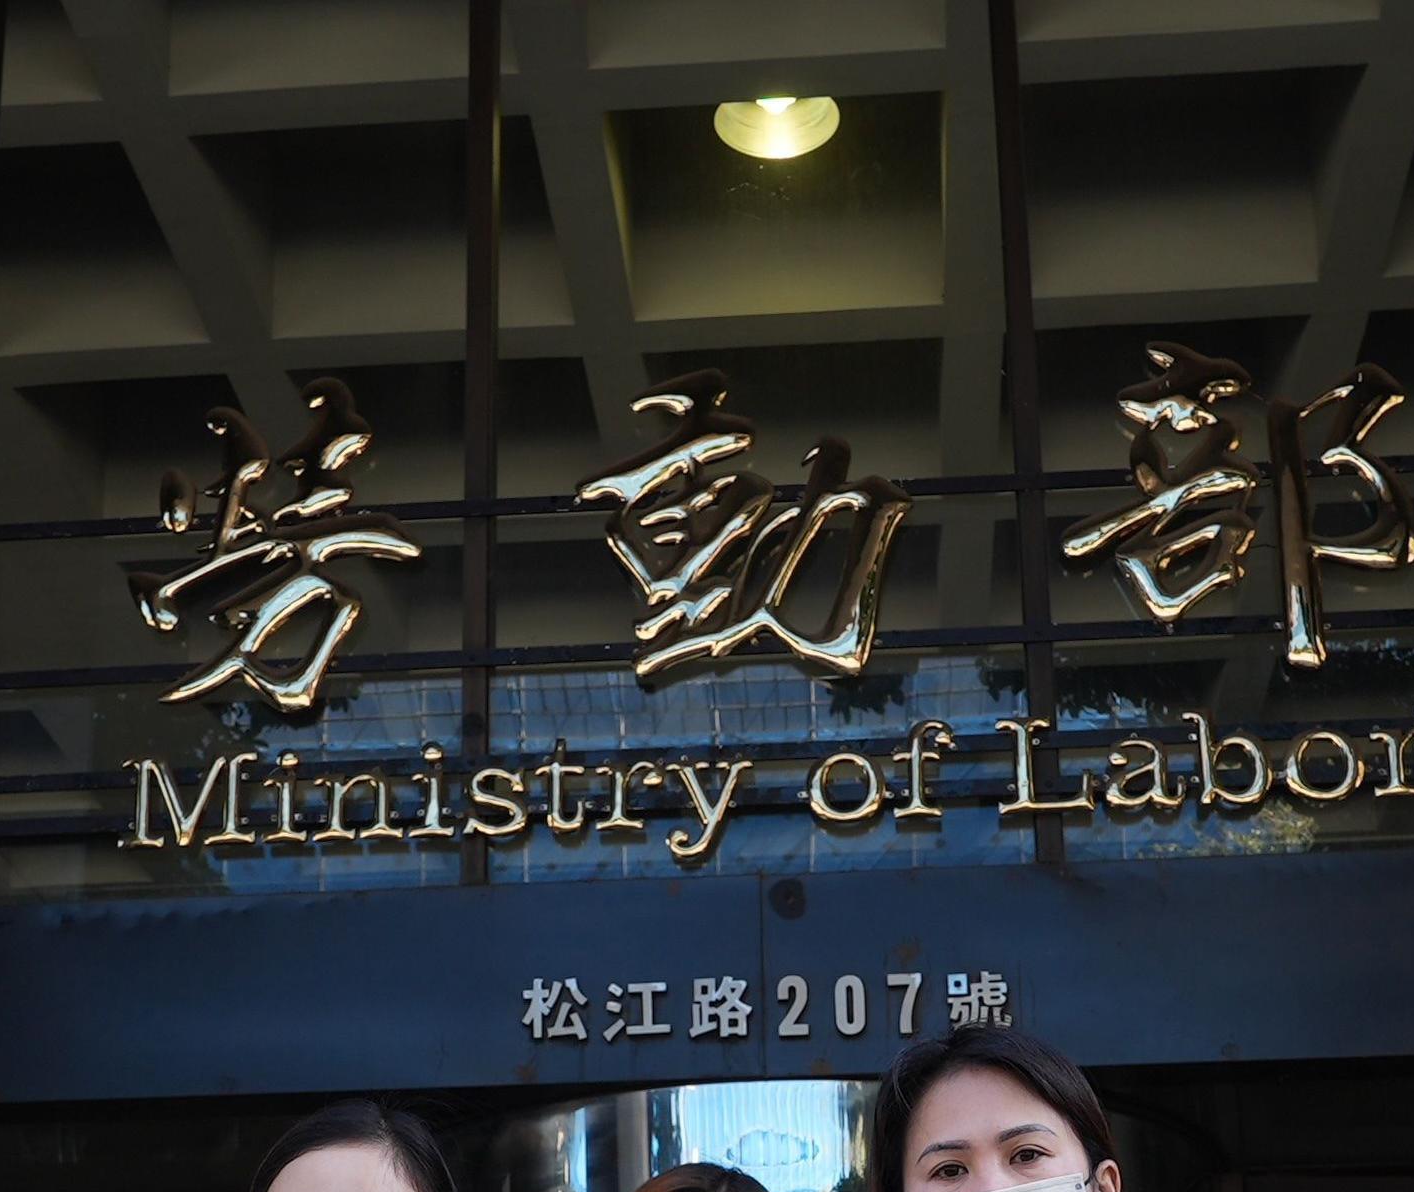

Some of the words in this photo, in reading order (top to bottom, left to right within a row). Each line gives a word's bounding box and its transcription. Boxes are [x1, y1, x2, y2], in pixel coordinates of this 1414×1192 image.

[118, 739, 753, 864] Ministry
[799, 719, 959, 825] of
[522, 971, 1013, 1041] 松江路207號
